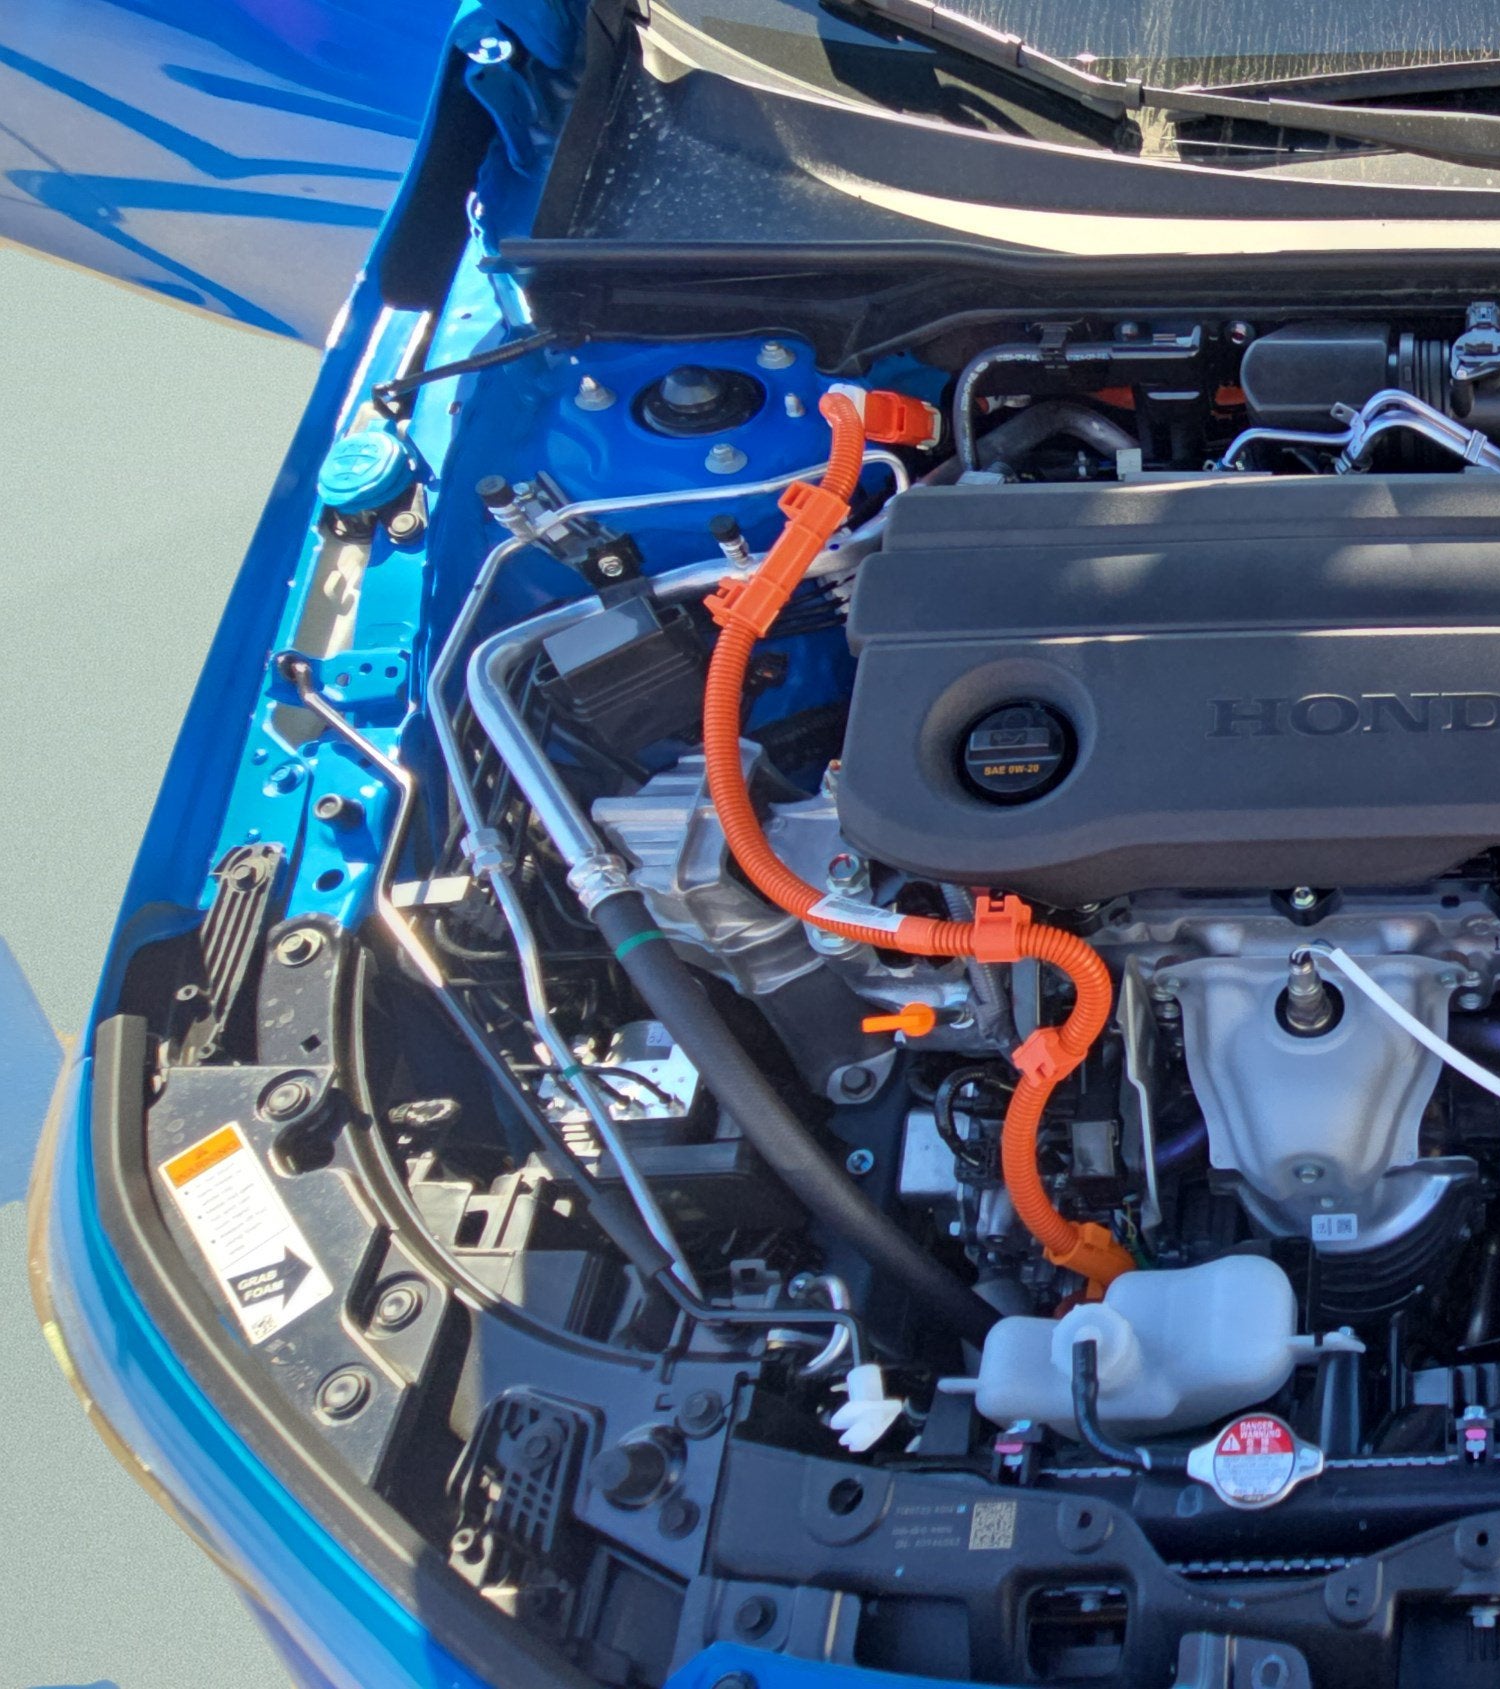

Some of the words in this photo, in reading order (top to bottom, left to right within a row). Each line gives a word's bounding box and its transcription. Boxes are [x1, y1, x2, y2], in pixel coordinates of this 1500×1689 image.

[984, 765, 1006, 776] SAE
[1008, 764, 1040, 775] 0W-20
[237, 1269, 278, 1291] GRAB
[243, 1279, 285, 1302] FOAM
